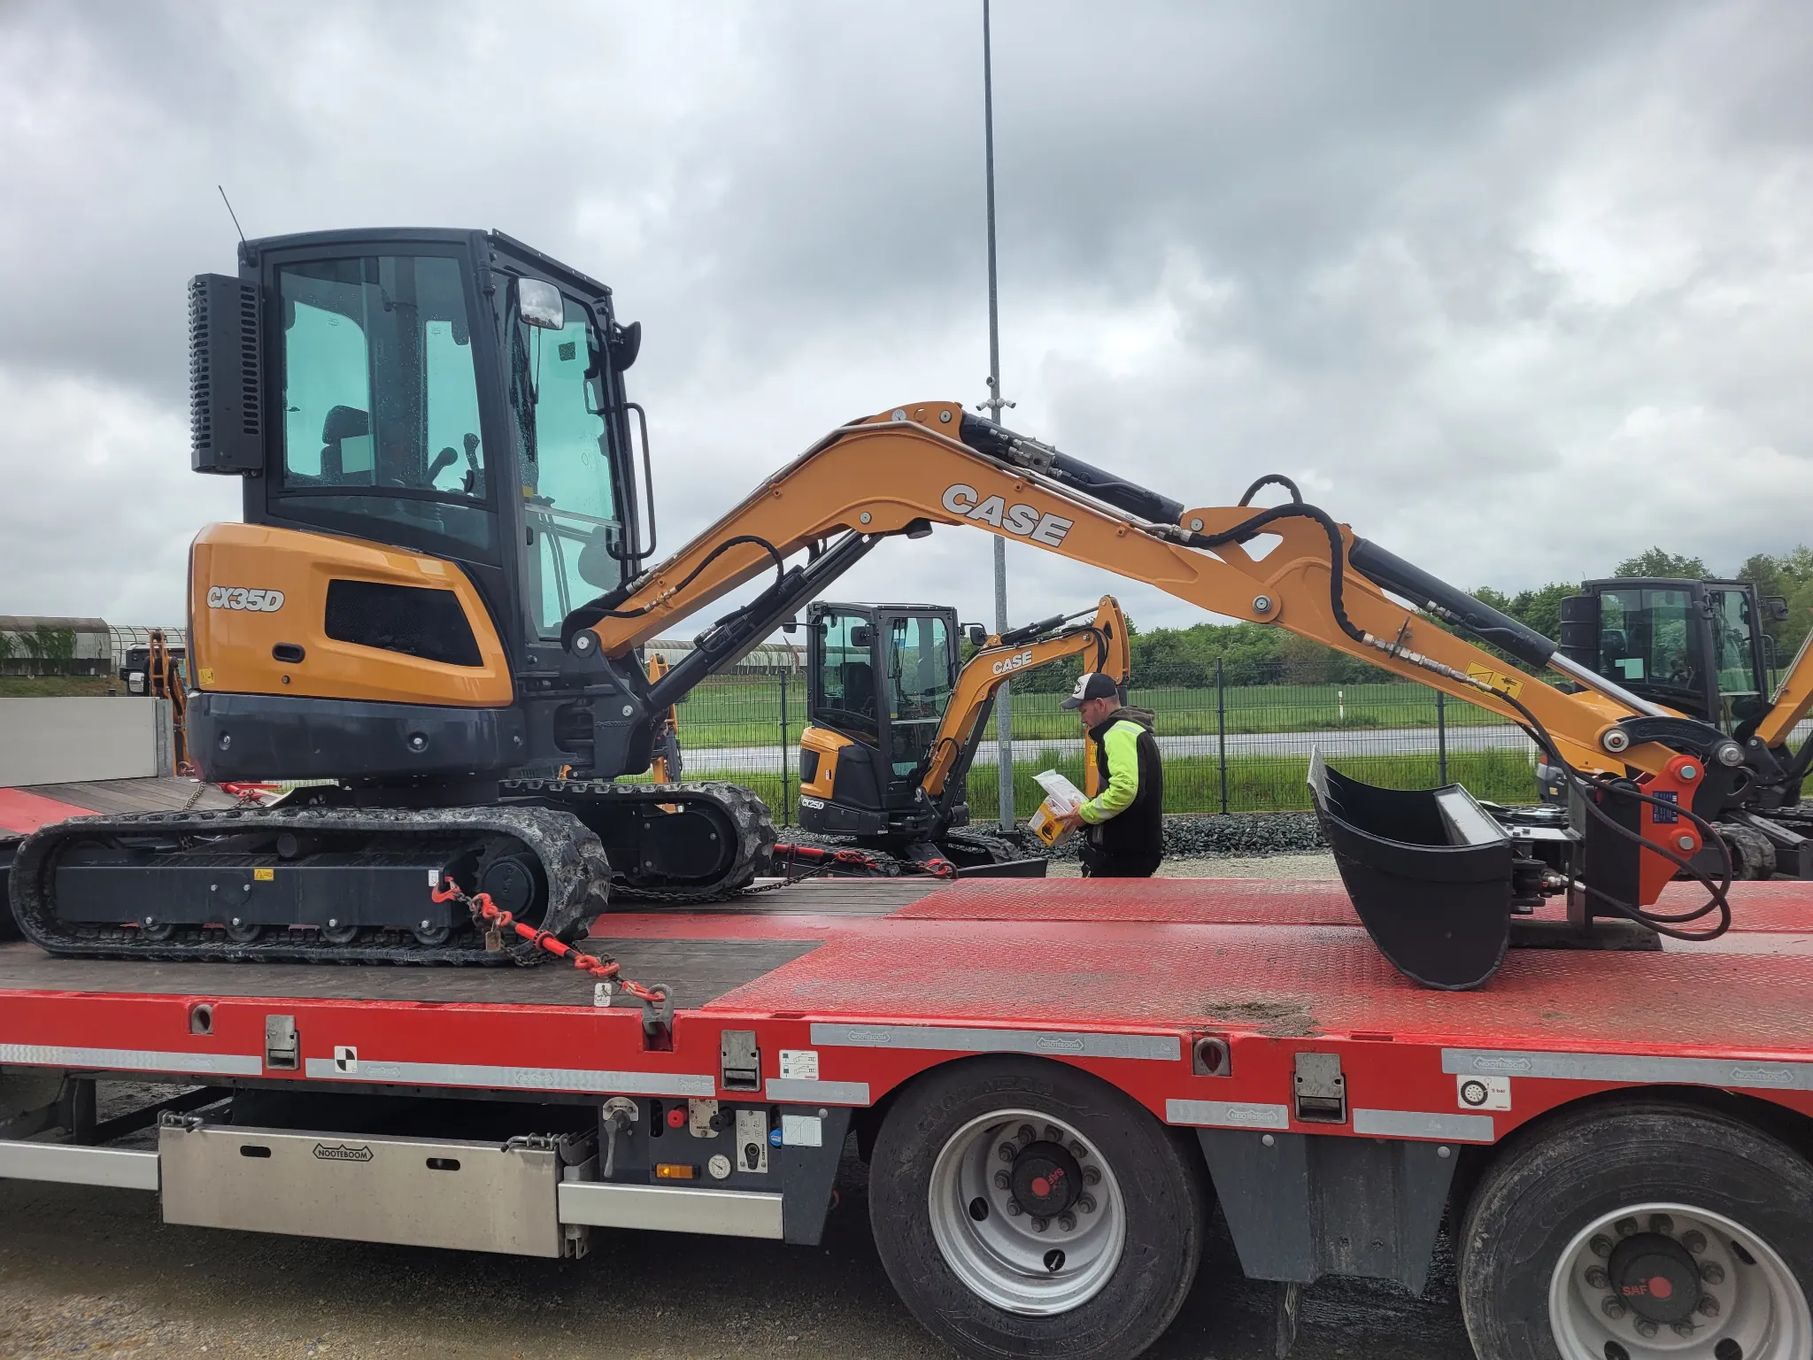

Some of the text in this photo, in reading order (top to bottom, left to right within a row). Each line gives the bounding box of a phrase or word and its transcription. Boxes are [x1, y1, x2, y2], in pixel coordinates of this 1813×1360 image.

[942, 483, 1075, 548] CASE
[206, 585, 285, 612] CX35D
[992, 650, 1032, 675] CASE
[801, 798, 825, 810] CX25D
[317, 1149, 368, 1159] NOOTEBOOM
[1047, 1167, 1065, 1185] SAF
[1621, 1284, 1648, 1296] SAF
